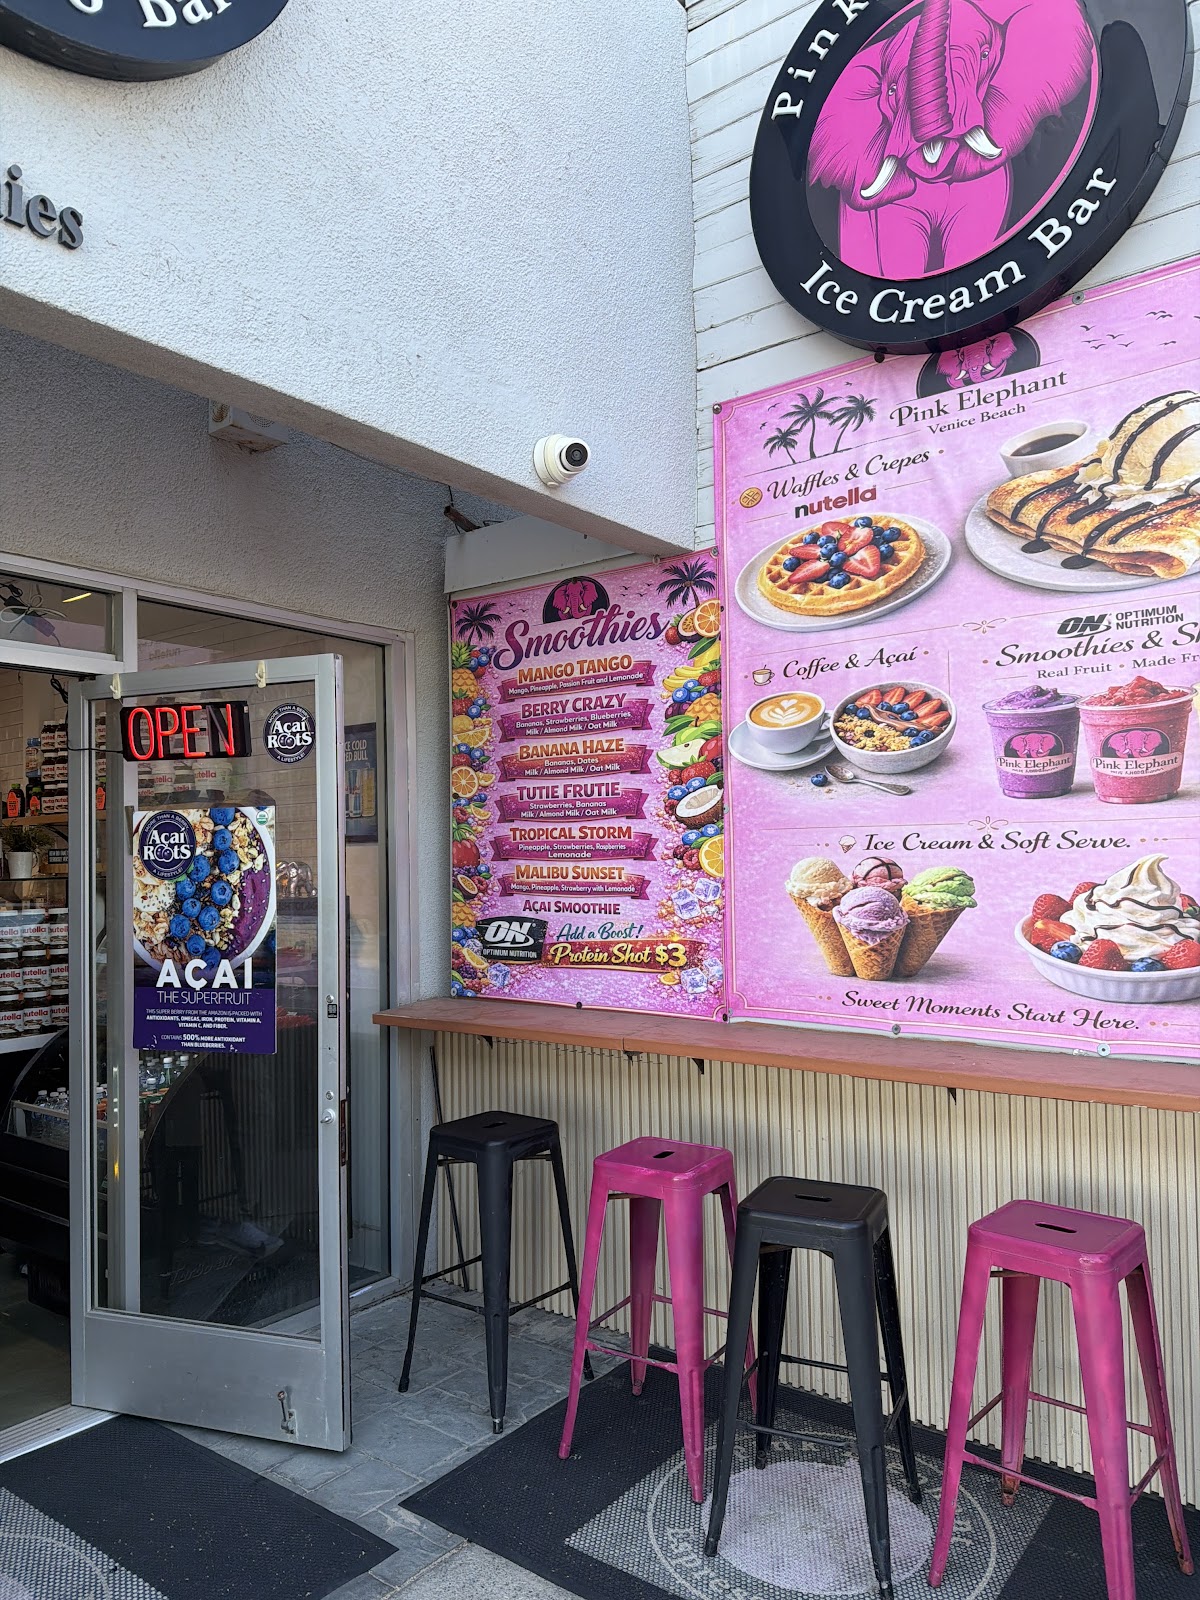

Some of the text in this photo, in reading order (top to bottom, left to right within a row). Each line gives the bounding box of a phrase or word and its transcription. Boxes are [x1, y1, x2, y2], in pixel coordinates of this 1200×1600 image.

[771, 0, 870, 122] Pink
[0, 164, 84, 250] ies
[799, 167, 1118, 324] Ice Cream Bar
[889, 371, 1069, 428] Pink Elephant
[927, 402, 1026, 435] Venice Beach
[767, 447, 930, 500] Waffles & Crepes
[794, 485, 877, 519] nutella
[1116, 605, 1178, 621] OPTIMUM
[1116, 613, 1184, 630] NUTRITION
[493, 604, 671, 671] Smoothies
[995, 635, 1134, 667] Smoothies
[1141, 630, 1164, 649] &
[518, 655, 632, 683] MANGO TANGO
[783, 646, 918, 680] Coffee & Açaí
[1037, 667, 1069, 679] Real
[1074, 662, 1112, 675] Fruit
[1132, 655, 1176, 669] Made
[530, 683, 558, 692] Pineapple,
[560, 681, 580, 689] Passion
[609, 672, 644, 682] Lemonade
[521, 693, 627, 718] BERRY CRAZY
[127, 703, 236, 760] OPEN
[515, 720, 544, 728] Bananas,
[546, 715, 588, 725] Strawberries,
[525, 720, 618, 736] Milk Almond Milk Oat Milk
[352, 740, 368, 751] COLD
[354, 750, 369, 761] BULL
[519, 738, 625, 760] BANANA HAZE
[544, 757, 598, 768] Bananas, Dates
[544, 767, 569, 775] Almond
[570, 765, 585, 773] Milk
[589, 764, 604, 772] Oat
[605, 763, 620, 771] Milk
[997, 757, 1022, 769] Pink
[1024, 756, 1071, 771] Elephant
[1092, 756, 1179, 771] Pink Elephant
[516, 782, 620, 801] TUTIE FRUTIE
[529, 800, 606, 810] Strawberries, Bananas
[585, 808, 600, 816] Oat
[601, 807, 617, 815] Milk
[509, 826, 632, 842] TROPICAL STORM
[863, 830, 1132, 854] Ice Cream & Soft Serve.
[518, 844, 552, 852] Pineapple,
[553, 843, 595, 851] Strawberries,
[515, 865, 625, 880] MALIBU SUNSET
[561, 884, 592, 893] Strawberry
[522, 900, 621, 915] AÇAI SMOOTHIE
[484, 920, 535, 947] ON
[556, 921, 644, 942] Add a Boost!
[482, 949, 537, 959] OPTIMUM NUTRITION
[549, 941, 688, 968] Protein Shot $3
[155, 957, 253, 991] AÇAI
[156, 990, 252, 1005] THE SUPERFRUIT
[841, 990, 1140, 1030] Sweet Moments Start Here.
